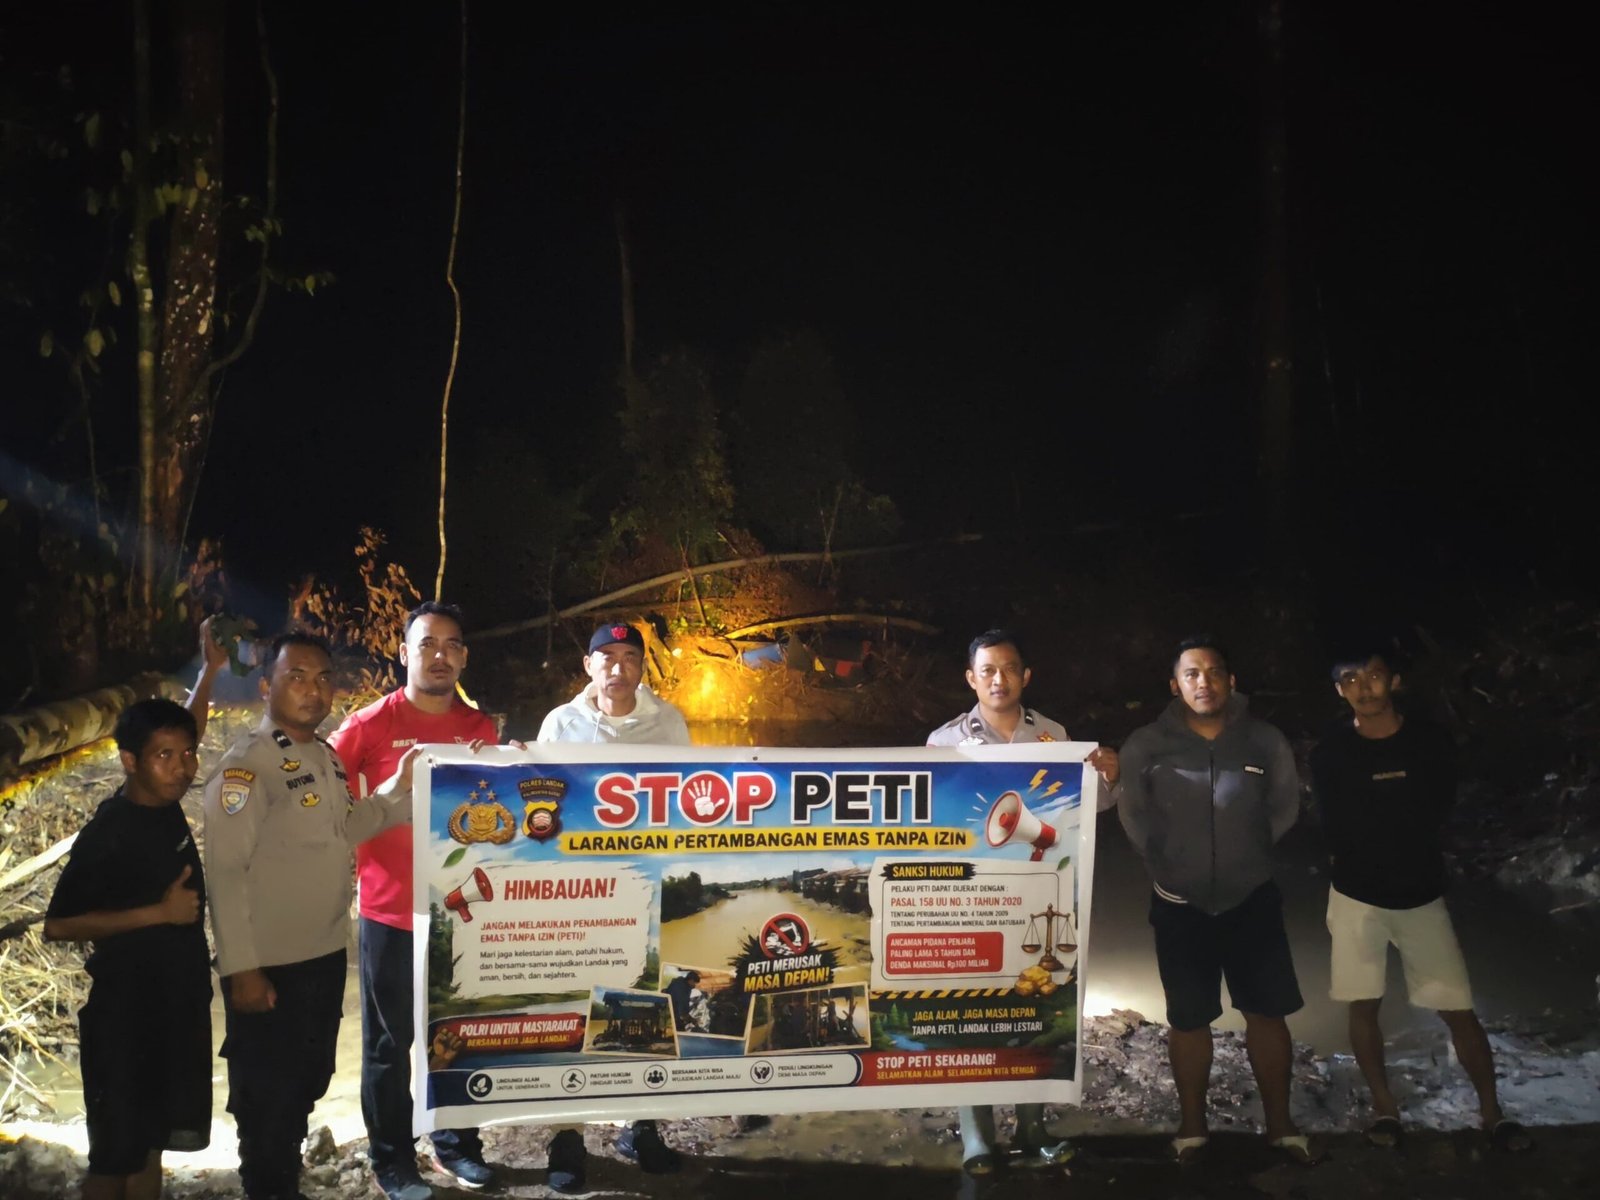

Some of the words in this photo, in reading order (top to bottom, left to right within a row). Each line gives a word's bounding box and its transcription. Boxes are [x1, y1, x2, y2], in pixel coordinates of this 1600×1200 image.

[594, 771, 776, 828] STOP
[791, 771, 932, 824] PETI
[569, 835, 668, 850] LARANGAN
[674, 832, 817, 849] PERTAMBANGAN
[823, 832, 870, 846] EMAS
[876, 832, 929, 846] TANPA
[934, 831, 966, 845] IZIN
[893, 866, 927, 877] SANKSI
[930, 866, 964, 877] HUKUM
[503, 877, 617, 901] HIMBAUAN!
[891, 885, 915, 893] PELAKU
[917, 885, 931, 893] PETI
[890, 897, 917, 907] PASAL
[920, 897, 934, 906] 158
[936, 897, 948, 906] UU
[949, 897, 964, 906] NO.
[966, 897, 971, 906] 3
[974, 897, 1000, 906] TAHUN
[1002, 897, 1022, 906] 2020
[480, 921, 516, 931] JANGAN
[518, 919, 571, 930] MELAKUKAN
[573, 917, 637, 928] PENAMBANGAN
[480, 933, 505, 943] EMAS
[508, 932, 536, 942] TANPA
[538, 931, 555, 941] IZIN
[557, 931, 586, 942] (PETI)!
[890, 938, 923, 947] ANCAMAN
[923, 938, 947, 946] PIDANA
[949, 937, 976, 946] PENJARA
[480, 951, 496, 959] Mari
[497, 950, 513, 960] jaga
[514, 948, 553, 957] kelestarian
[554, 948, 575, 957] alam,
[575, 948, 598, 957] patuhi
[890, 949, 913, 958] PALING
[914, 949, 933, 957] LAMA
[479, 963, 493, 971] dan
[494, 961, 548, 970] bersama-sama
[549, 959, 584, 969] wujudkan
[584, 958, 610, 967] Landak
[611, 959, 628, 968] yang
[748, 961, 771, 975] PETI
[773, 954, 822, 972] MERUSAK
[890, 961, 912, 970] DENDA
[912, 960, 946, 969] MAKSIMAL
[968, 959, 989, 967] MILIAR
[479, 974, 501, 982] aman,
[502, 973, 526, 982] bersih,
[528, 972, 542, 980] dan
[543, 971, 577, 981] sejahtera.
[744, 973, 780, 992] MASA
[784, 967, 830, 986] DEPAN!
[913, 1010, 934, 1022] JAGA
[962, 1009, 983, 1020] JAGA
[985, 1008, 1008, 1019] MASA
[1010, 1007, 1036, 1018] DEPAN
[460, 1023, 489, 1037] POLRI
[490, 1022, 520, 1035] UNTUK
[522, 1019, 579, 1033] MASYARAKAT
[912, 1024, 936, 1036] TANPA
[938, 1024, 957, 1035] PETI,
[958, 1023, 989, 1034] LANDAK
[991, 1022, 1013, 1033] LEBIH
[1013, 1021, 1042, 1032] LESTARI
[467, 1038, 501, 1047] BERSAMA
[503, 1037, 519, 1045] KITA
[520, 1036, 539, 1045] JAGA
[877, 1056, 904, 1069] STOP
[908, 1055, 931, 1068] PETI
[935, 1053, 996, 1067] SEKARANG!
[877, 1070, 922, 1079] SELAMATKAN
[924, 1069, 943, 1077] ALAM
[948, 1067, 992, 1077] SELAMATKAN
[994, 1067, 1009, 1075] KITA
[1011, 1066, 1037, 1074] SEMUA!
